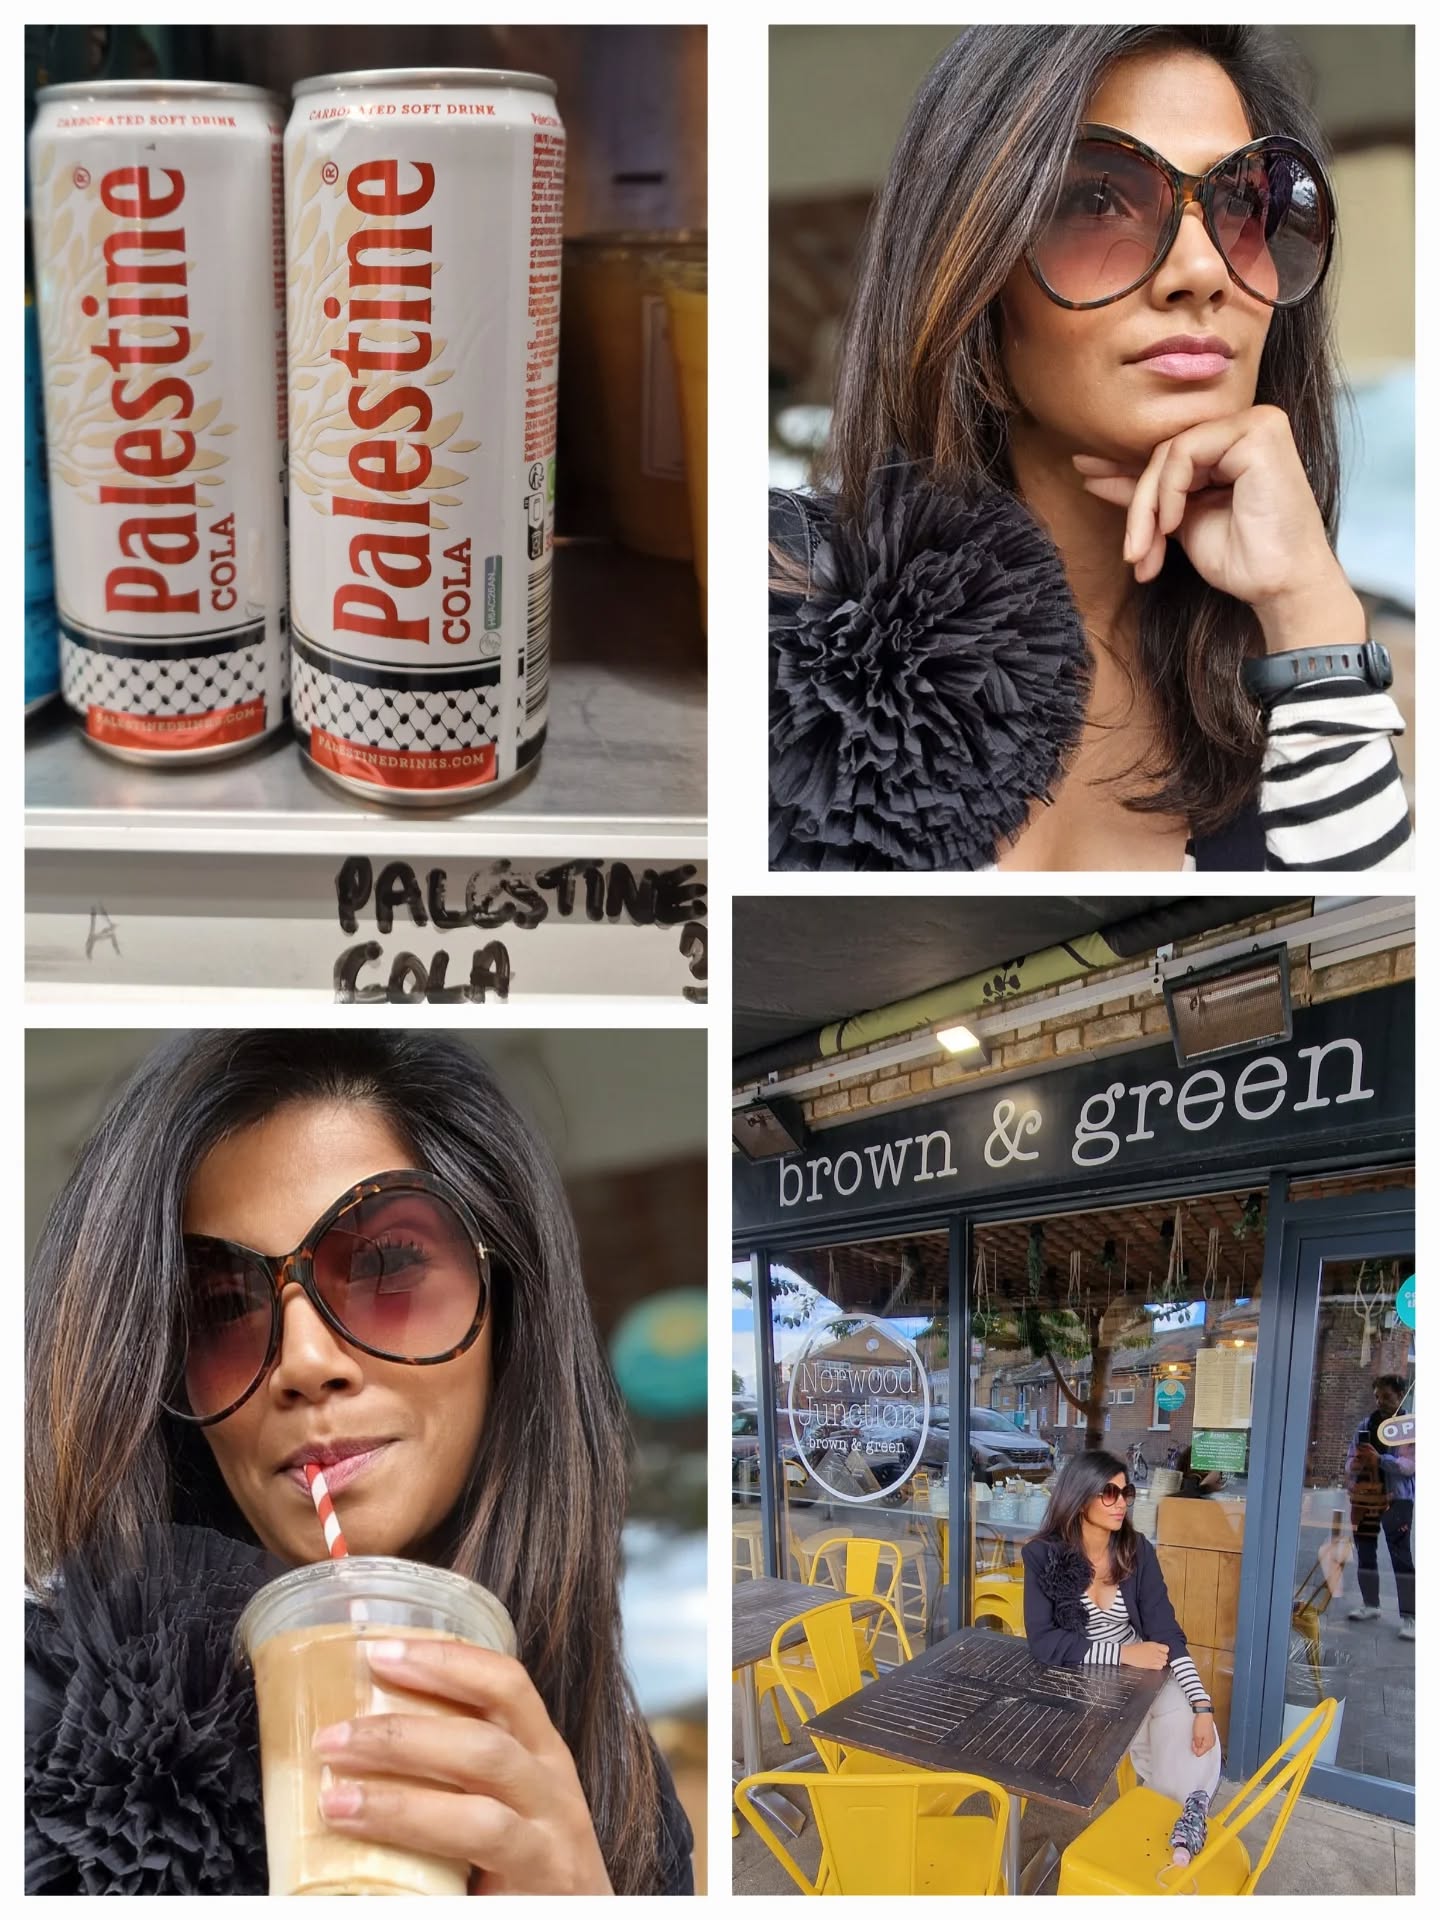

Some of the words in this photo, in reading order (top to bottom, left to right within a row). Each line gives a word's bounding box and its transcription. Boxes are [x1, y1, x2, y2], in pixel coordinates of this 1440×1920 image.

[150, 115, 187, 127] SOFT
[192, 115, 237, 128] DRINK
[308, 104, 396, 120] CARBOATED
[402, 104, 442, 115] SOFT
[447, 104, 496, 115] DRINK
[81, 165, 200, 614] Palestine
[323, 159, 436, 645] Palestine
[209, 511, 238, 611] COLA
[442, 537, 472, 645] COLA
[318, 735, 485, 770] PALESTINEDRINKS.COM
[335, 855, 708, 934] PALESTINE
[333, 940, 518, 1004] COLA
[779, 1129, 958, 1208] brown
[983, 1098, 1043, 1169] &
[1071, 1037, 1375, 1167] green
[800, 1360, 916, 1394] Norwood
[798, 1396, 919, 1429] Junction
[808, 1436, 848, 1451] brown
[851, 1437, 862, 1452] &
[866, 1440, 906, 1455] green
